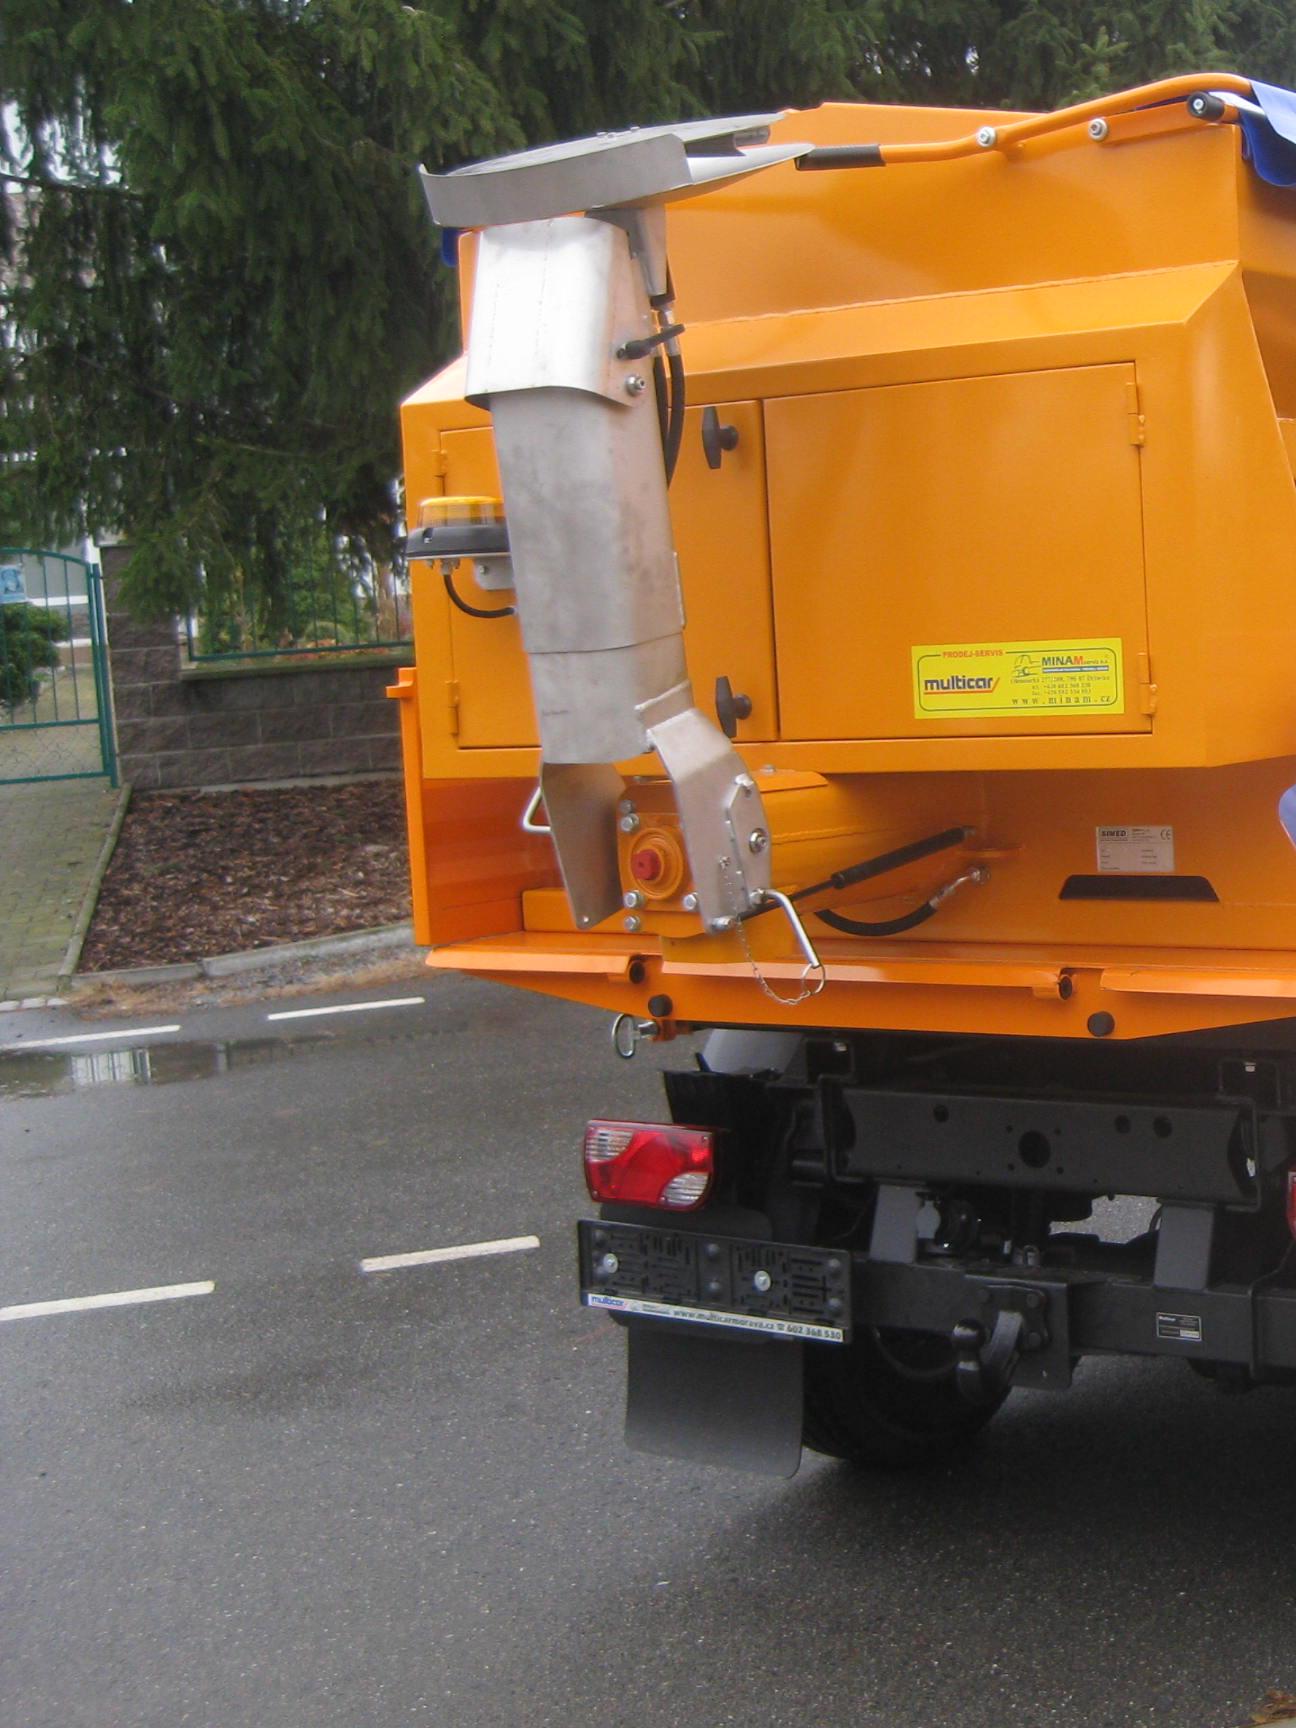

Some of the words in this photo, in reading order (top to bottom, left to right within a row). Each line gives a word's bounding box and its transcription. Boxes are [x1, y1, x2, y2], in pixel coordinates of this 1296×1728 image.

[1041, 656, 1084, 667] MINAM
[924, 675, 993, 691] multicar
[591, 1295, 625, 1308] multicar
